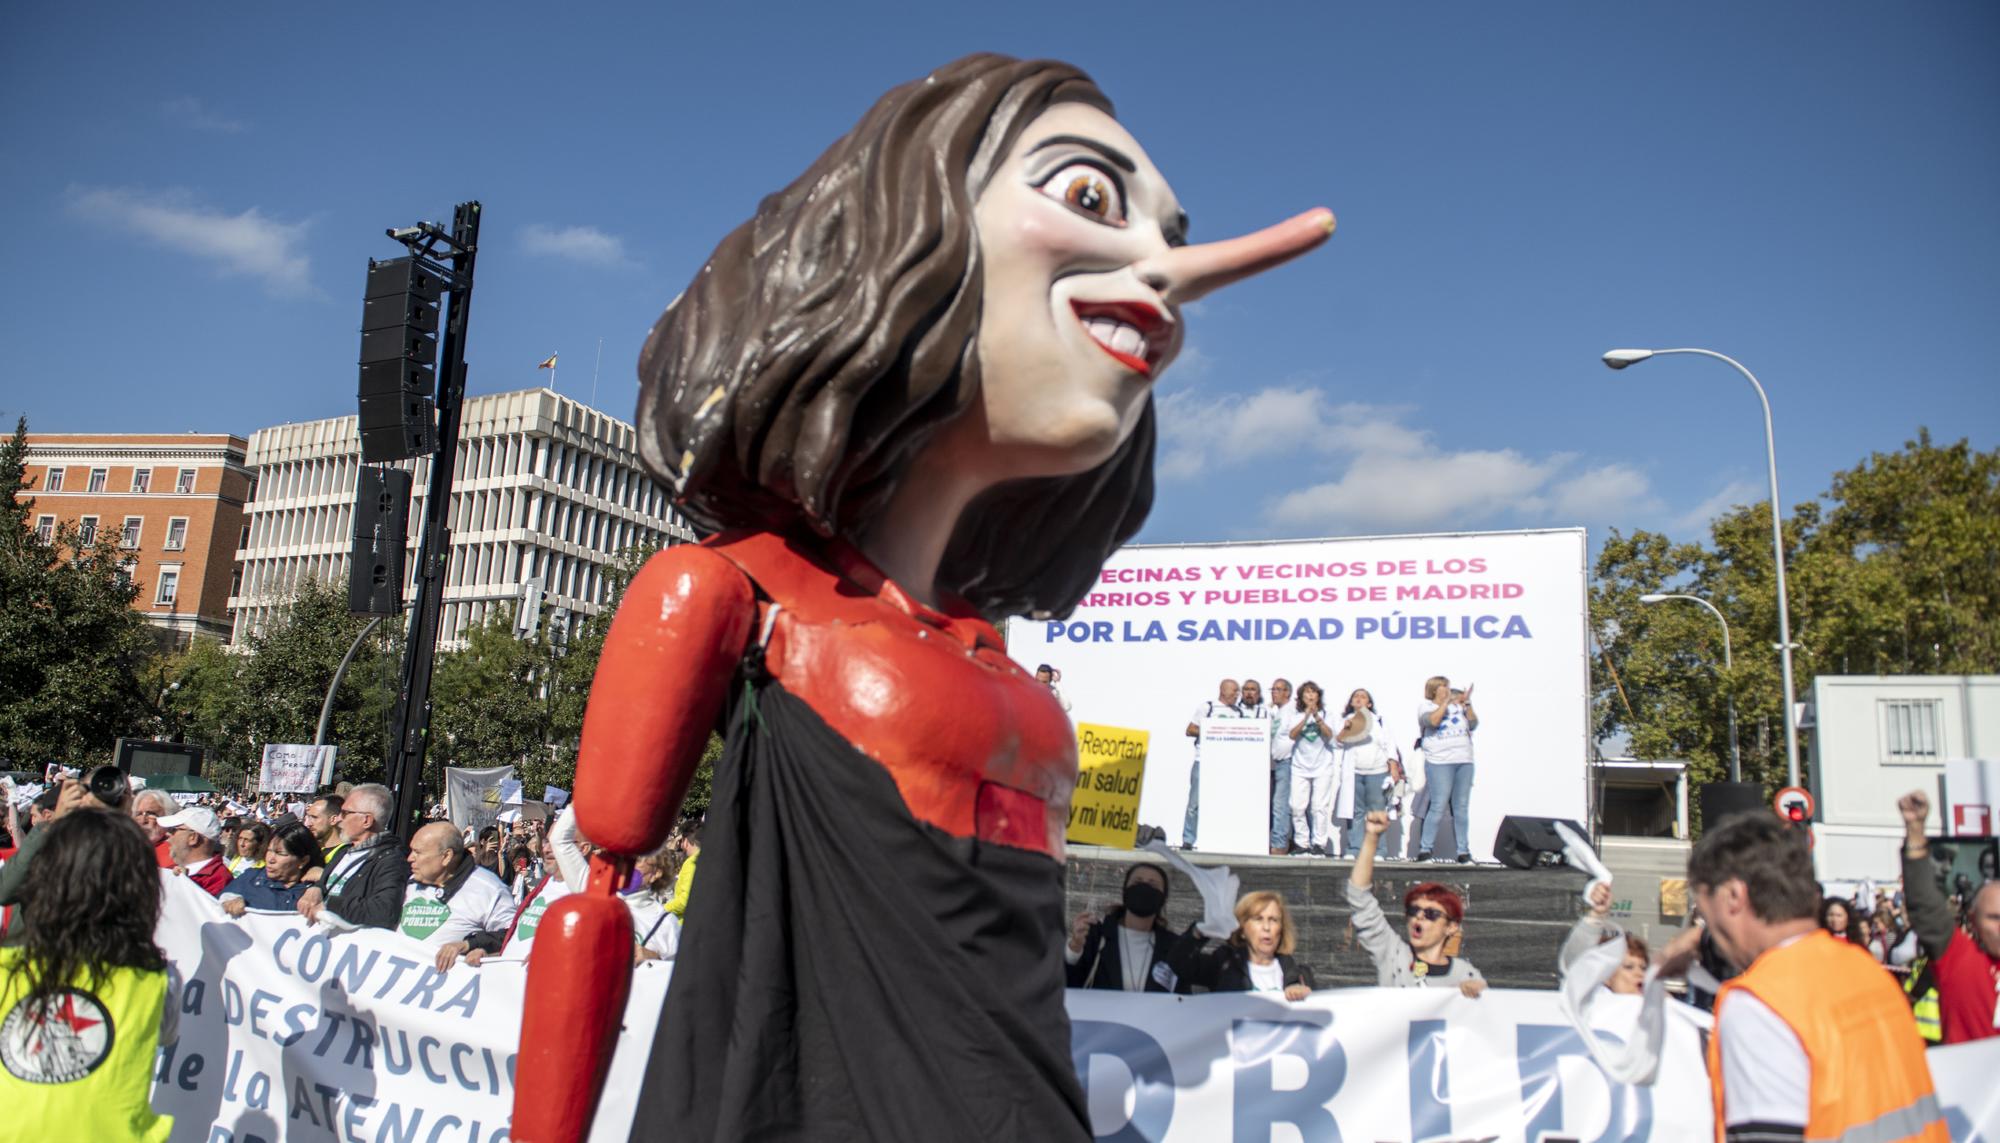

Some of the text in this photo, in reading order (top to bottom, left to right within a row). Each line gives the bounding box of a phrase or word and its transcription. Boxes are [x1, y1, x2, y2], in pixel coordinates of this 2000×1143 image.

[1210, 566, 1228, 581] Y
[1236, 561, 1368, 580] VECINOS
[1376, 560, 1417, 576] DE
[1426, 558, 1488, 574] LOS
[1178, 591, 1196, 606] Y
[1204, 588, 1339, 605] PUEBLOS
[1347, 586, 1388, 602] DE
[1396, 583, 1525, 600] MADRID
[1046, 611, 1533, 643] POR LA SANIDAD PÚBLICA
[1094, 769, 1140, 796] salud
[1079, 802, 1100, 828] mi
[1101, 804, 1136, 832] vida!
[407, 906, 445, 915] SANIDAD
[273, 928, 481, 1019] CONTRA
[222, 977, 517, 1096] DESTRUCCI
[223, 1050, 271, 1110] la
